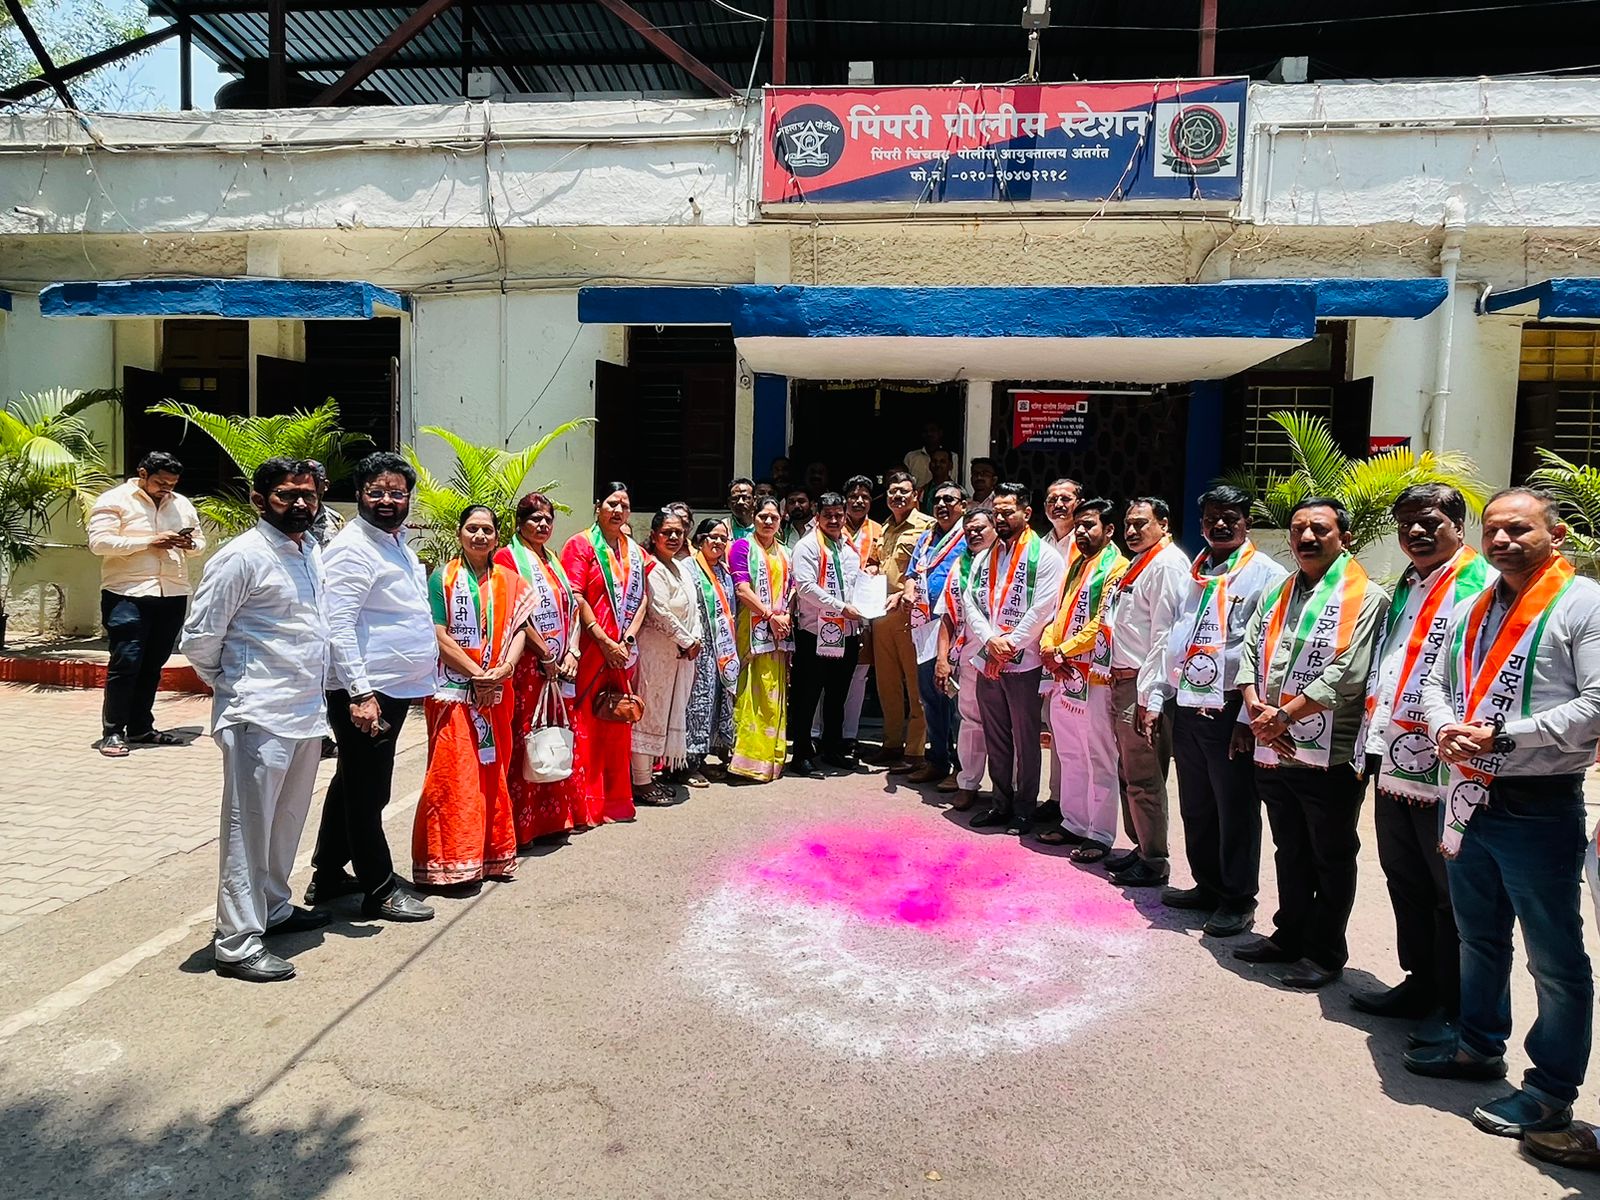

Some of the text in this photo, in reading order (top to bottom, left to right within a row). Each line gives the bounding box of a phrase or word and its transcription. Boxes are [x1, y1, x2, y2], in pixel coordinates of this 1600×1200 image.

[847, 105, 932, 140] पिंपरी
[941, 103, 1048, 141] पोलीस
[1058, 101, 1148, 139] स्टेशन
[871, 147, 901, 161] पिंपरी
[957, 146, 995, 161] पोलीस
[1000, 148, 1067, 164] आयुक्तालय
[1071, 144, 1110, 159] अंतर्गत
